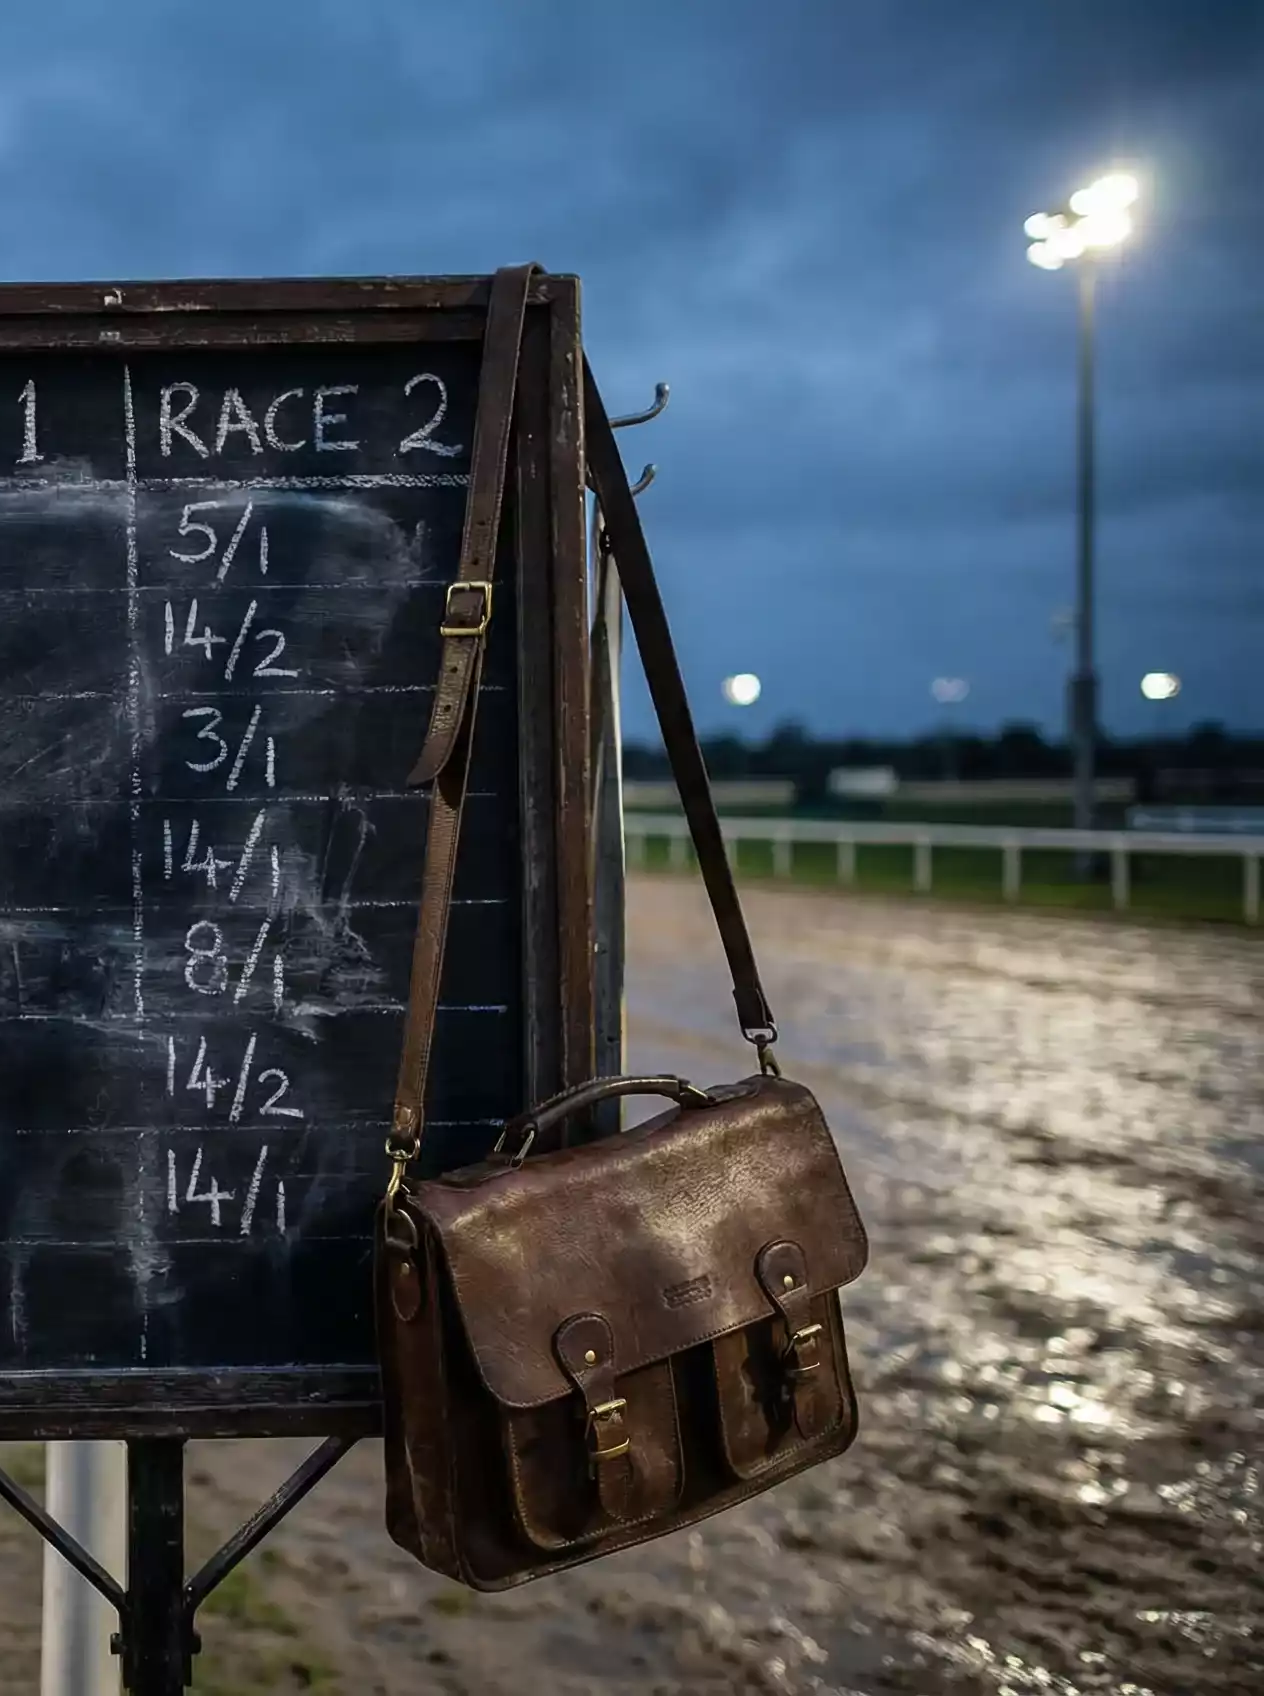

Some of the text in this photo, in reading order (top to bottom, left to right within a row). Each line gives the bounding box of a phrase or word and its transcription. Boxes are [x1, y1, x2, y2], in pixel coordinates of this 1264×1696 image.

[15, 379, 45, 464] 1
[159, 372, 464, 459] RACE 2
[169, 500, 269, 582] 5/1
[164, 598, 302, 681] 14/2
[182, 704, 276, 791] 3/1
[163, 808, 280, 902] 14/1
[184, 918, 284, 1015] 8/1
[168, 1032, 305, 1122] 14/2
[167, 1145, 287, 1236] 14/1
